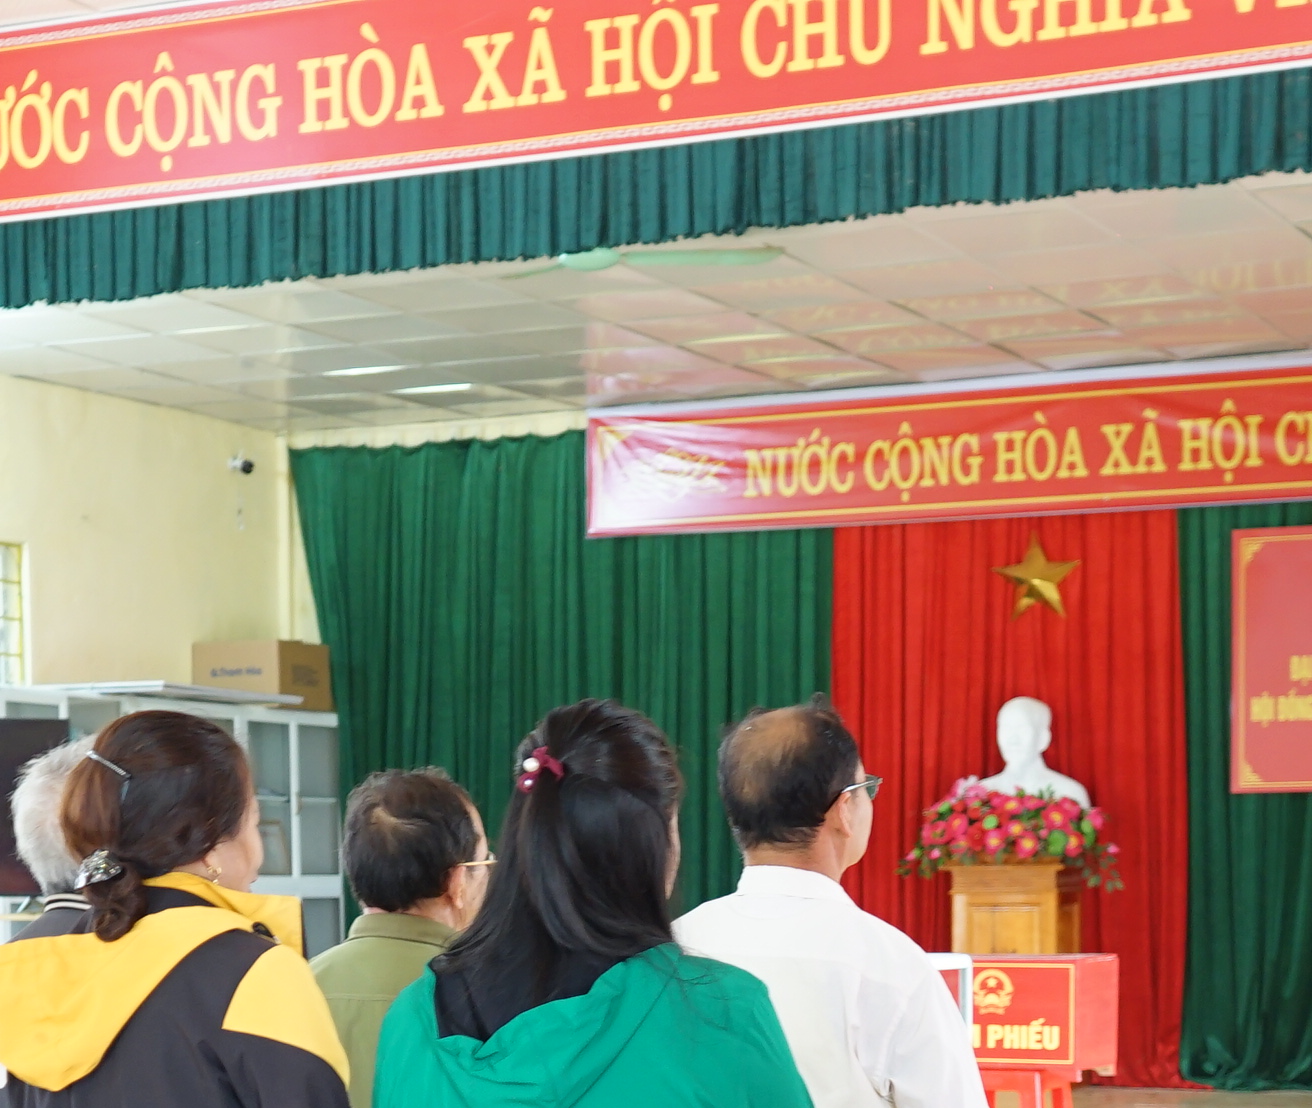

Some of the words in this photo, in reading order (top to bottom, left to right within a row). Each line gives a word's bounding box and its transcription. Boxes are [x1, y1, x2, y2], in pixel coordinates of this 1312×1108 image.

[105, 52, 282, 171] CỘNG
[298, 23, 444, 134] HÒA
[463, 6, 566, 114] XÃ
[585, 0, 719, 112] HỘI
[744, 427, 856, 499] NƯỚC
[863, 422, 983, 502] CỘNG
[993, 410, 1089, 483] HÒA
[1100, 408, 1166, 478] XÃ
[1177, 399, 1263, 482] HỘI
[987, 1018, 1060, 1050] PHIẾU
